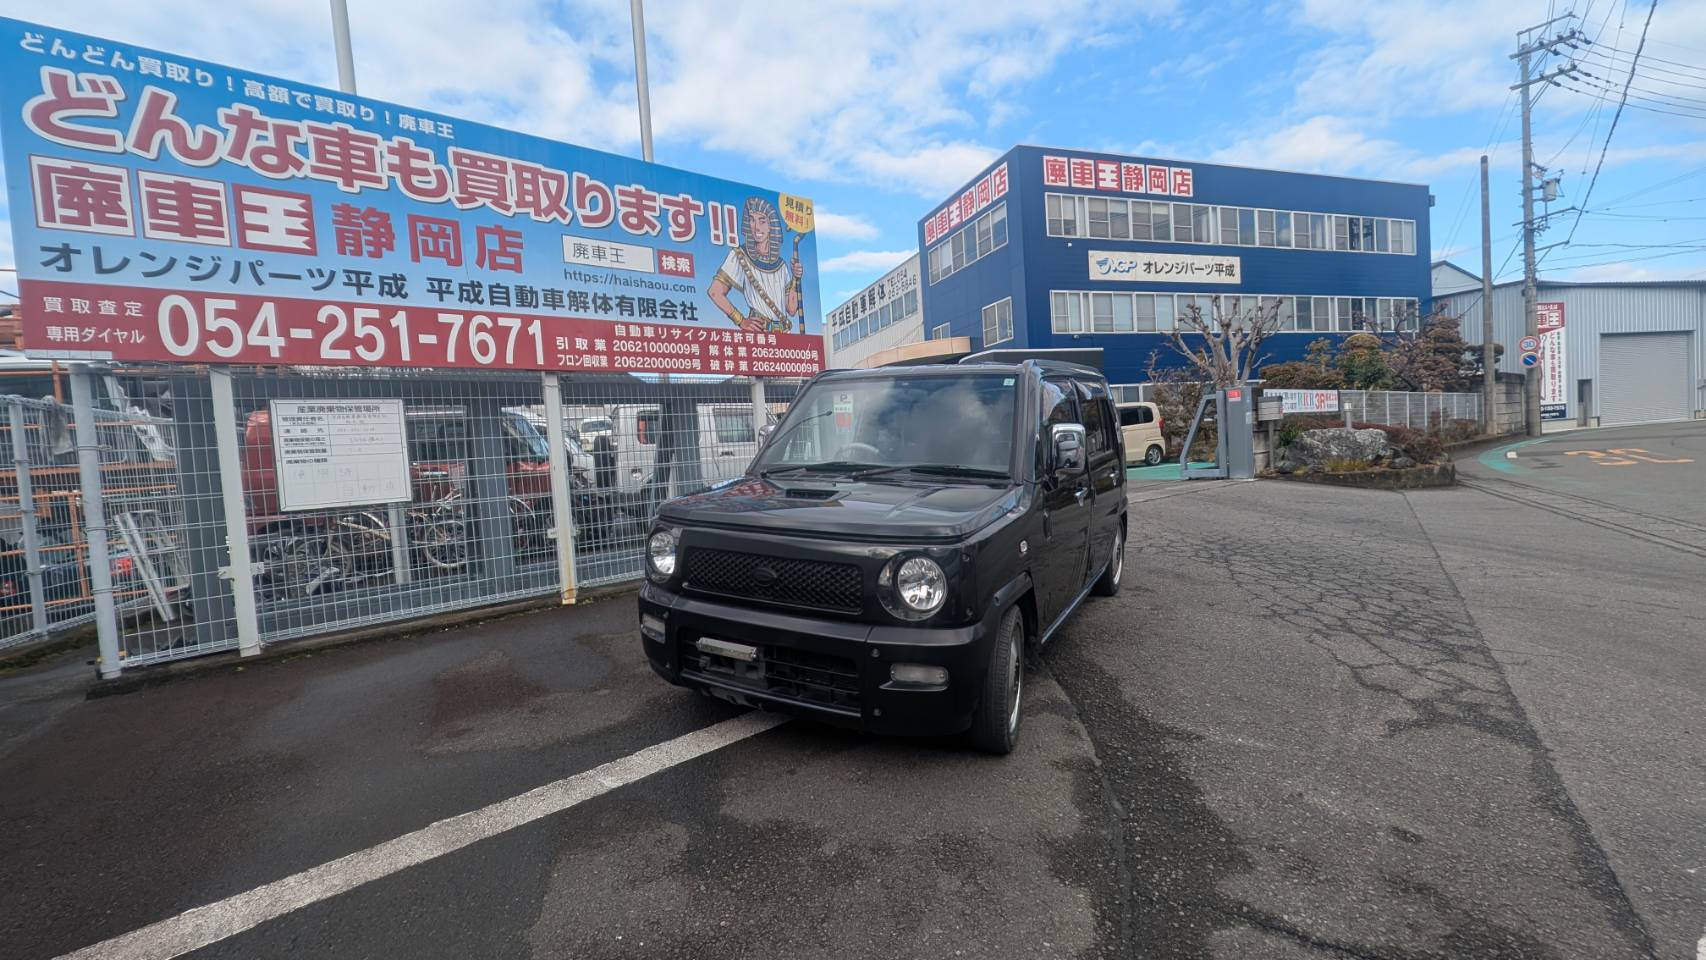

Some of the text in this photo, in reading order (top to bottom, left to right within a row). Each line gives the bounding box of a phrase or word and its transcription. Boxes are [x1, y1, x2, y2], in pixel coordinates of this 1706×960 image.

[1044, 156, 1193, 197] 廃車王静岡店
[573, 242, 691, 273] 廃車王 検索
[40, 242, 699, 321] オレンジパーツ平成 平成自動車解体有限会社
[564, 269, 696, 294] https://haishaou.com
[43, 296, 144, 317] 買取査定
[46, 325, 145, 344] 専用ダイヤル
[157, 294, 545, 365] 054-251-7671
[615, 324, 777, 345] 自動車リサイクル法許可番号
[556, 336, 607, 352] 引取業
[709, 344, 748, 358] 解体業
[557, 354, 609, 368] フロン回収業
